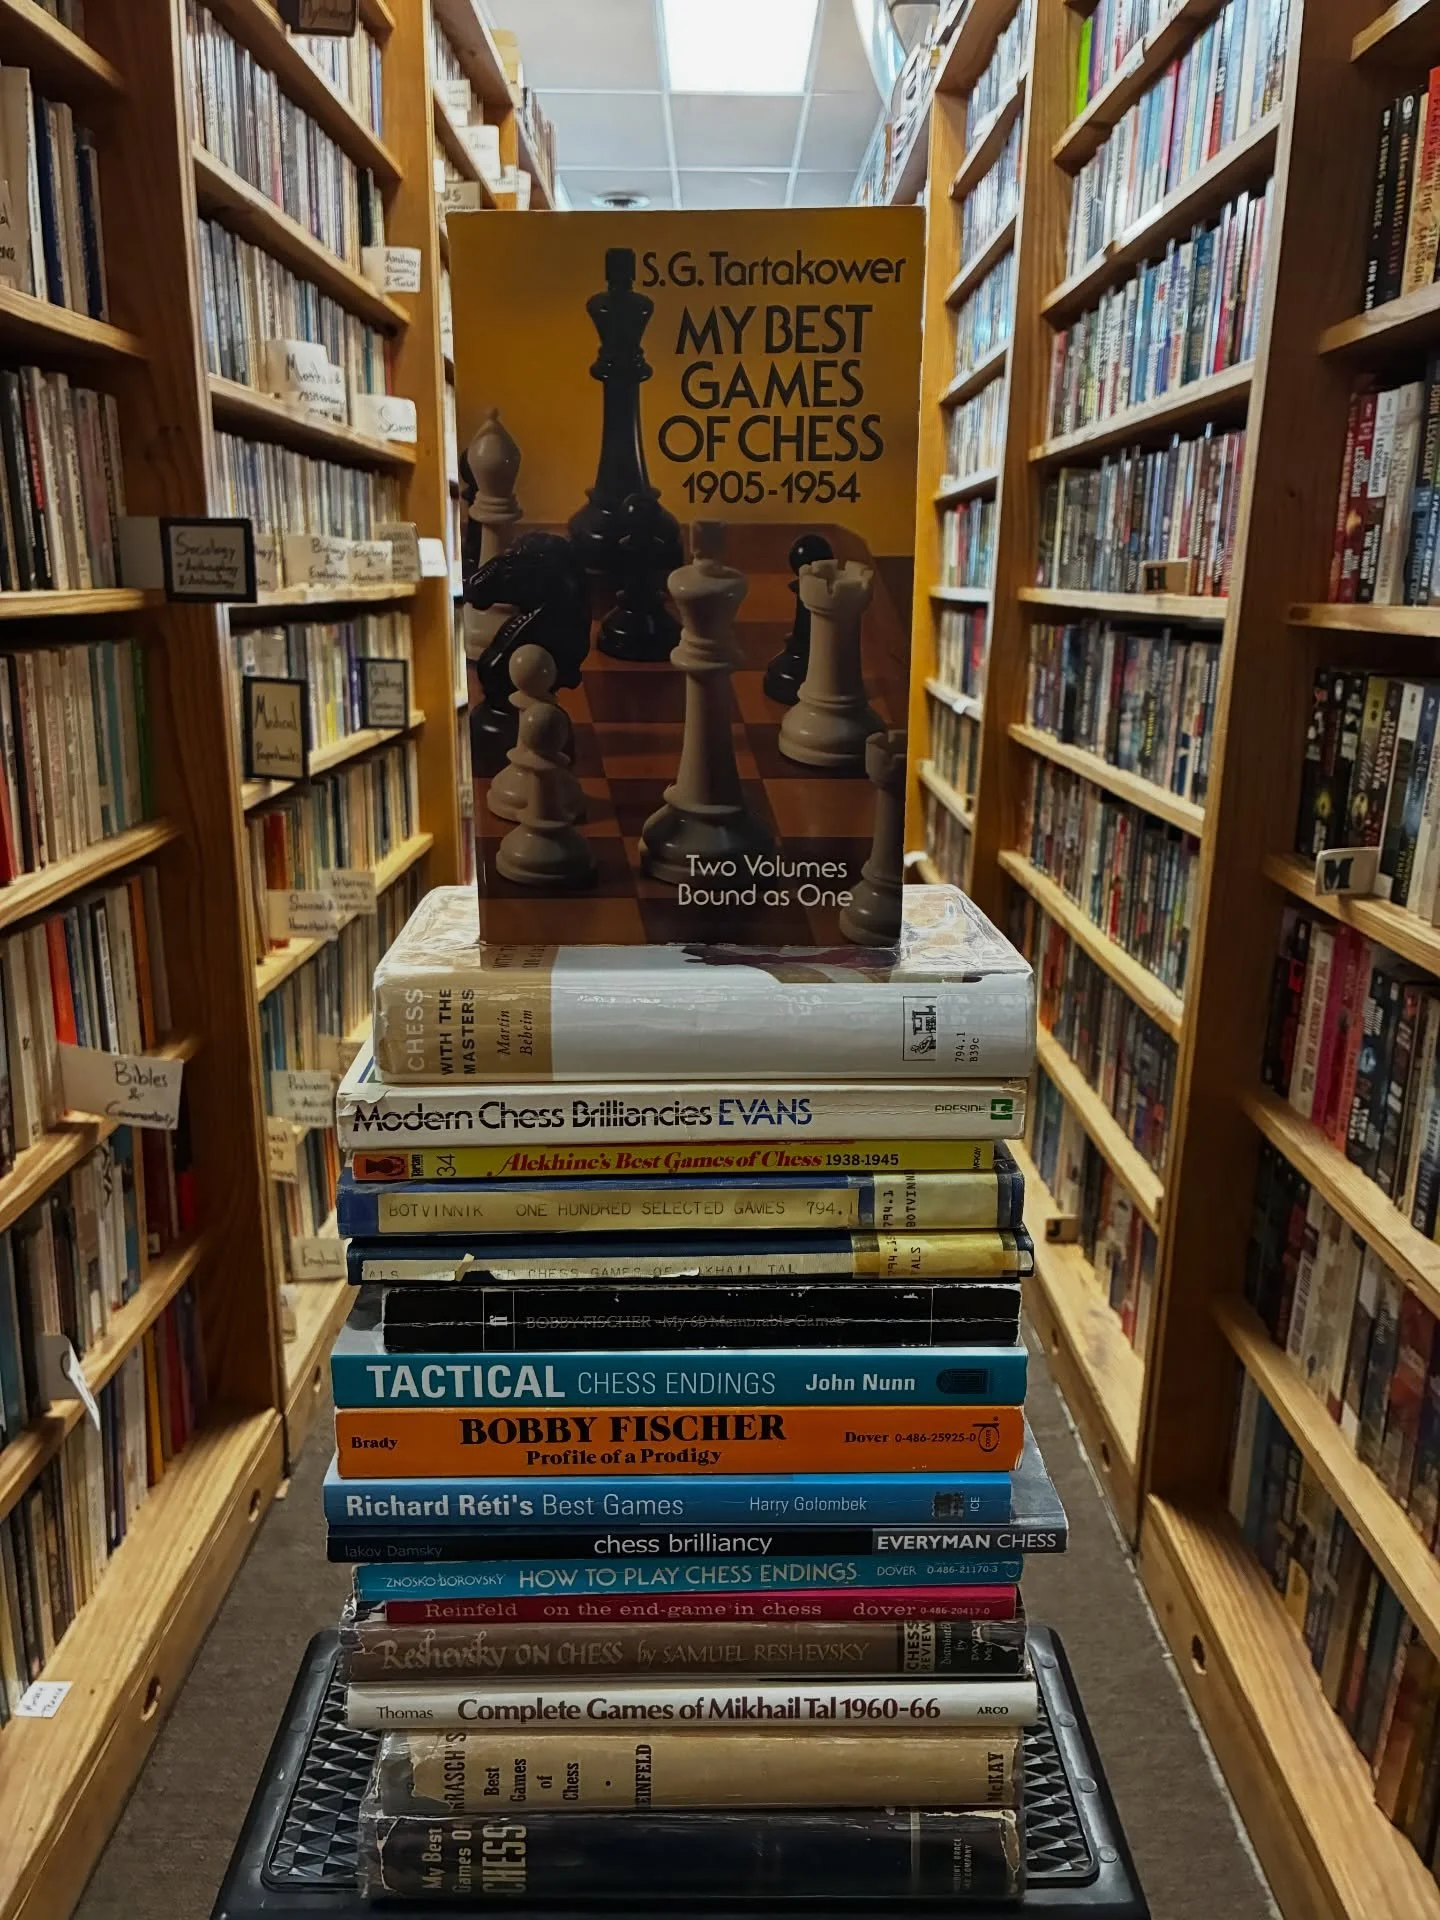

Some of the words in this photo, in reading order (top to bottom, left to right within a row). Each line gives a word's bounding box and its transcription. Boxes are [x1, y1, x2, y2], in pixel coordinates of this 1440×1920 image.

[642, 250, 705, 288] S.G.
[709, 249, 906, 287] Tartakower
[1363, 285, 1375, 309] LAN
[675, 305, 757, 355] MY
[765, 303, 873, 355] BEST
[680, 359, 865, 410] GAMES
[658, 415, 731, 464] OF
[737, 413, 885, 463] CHESS
[682, 471, 862, 505] 1905-1954
[175, 531, 236, 563] Sociology
[685, 854, 737, 877] Two
[743, 854, 848, 878] Volumes
[1322, 857, 1354, 891] M
[677, 883, 757, 907] Bound
[763, 891, 790, 907] as
[797, 883, 854, 907] One
[438, 988, 452, 1026] THE
[405, 987, 425, 1072] CHESS
[461, 988, 476, 1075] MASTERS
[496, 1009, 511, 1056] Martin
[439, 1032, 455, 1076] WITH
[954, 1031, 966, 1062] 794.1
[969, 1037, 980, 1062] B39c
[114, 1060, 169, 1088] Bibles
[353, 1103, 473, 1132] Modern
[479, 1101, 565, 1130] Chess
[572, 1099, 712, 1128] Brilliancies
[718, 1098, 813, 1126] EVANS
[436, 1153, 456, 1177] 34
[489, 1151, 611, 1178] Alekhine's
[615, 1153, 662, 1170] Best
[663, 1151, 734, 1173] Games
[735, 1150, 757, 1168] of
[761, 1150, 822, 1168] Chess
[825, 1152, 899, 1167] 1938-1945
[388, 1203, 484, 1218] BOTVINNIK
[515, 1202, 548, 1218] ONE
[558, 1202, 632, 1217] HUNDRED
[642, 1200, 724, 1216] SELECTED
[733, 1200, 785, 1216] GAMES
[882, 1190, 895, 1228] 794.1
[526, 1314, 579, 1330] BOBBY
[583, 1314, 652, 1330] FISCHER
[662, 1314, 685, 1332] My
[710, 1313, 791, 1328] Memorable
[794, 1313, 846, 1328] Games
[366, 1364, 566, 1398] TACTICAL
[577, 1371, 656, 1394] CHESS
[666, 1371, 776, 1394] ENDINGS
[805, 1373, 855, 1391] John
[862, 1373, 915, 1391] Nunn
[350, 1436, 399, 1451] Brady
[459, 1416, 598, 1445] BOBBY
[609, 1414, 788, 1443] FISCHER
[843, 1431, 889, 1444] Dover
[894, 1431, 977, 1443] 0-486-25925-0
[526, 1449, 598, 1466] Profile
[600, 1448, 624, 1464] of
[625, 1452, 636, 1464] a
[640, 1447, 722, 1467] Prodigy
[346, 1494, 449, 1518] Richard
[459, 1493, 534, 1516] Réti's
[542, 1494, 595, 1516] Best
[603, 1492, 684, 1517] Games
[749, 1496, 789, 1517] Harry
[794, 1495, 868, 1512] Golombek
[386, 1543, 443, 1560] Damsky
[593, 1535, 660, 1555] chess
[669, 1532, 773, 1555] brilliancy
[877, 1533, 991, 1550] EVERYMAN
[996, 1533, 1057, 1549] CHESS
[519, 1568, 579, 1589] HOW
[584, 1567, 617, 1587] TO
[624, 1566, 681, 1586] PLAY
[685, 1565, 752, 1585] CHESS
[760, 1562, 858, 1583] ENDINGS
[876, 1565, 917, 1577] DOVER
[425, 1603, 519, 1618] Reinfeld
[543, 1605, 569, 1617] on
[578, 1603, 612, 1617] the
[618, 1602, 727, 1619] end-game
[735, 1602, 755, 1615] in
[762, 1602, 822, 1616] chess
[853, 1602, 916, 1617] dover
[373, 1631, 513, 1670] Reshevsky
[515, 1645, 550, 1665] ON
[557, 1642, 623, 1666] CHESS
[637, 1640, 657, 1664] by
[664, 1643, 749, 1664] SAMUEL
[753, 1642, 869, 1662] RESHEVSKY
[906, 1621, 920, 1671] CHESS
[376, 1706, 433, 1720] Thomas
[457, 1697, 581, 1724] Complete
[586, 1697, 674, 1721] Games
[678, 1697, 705, 1720] of
[708, 1696, 801, 1720] Mikhail
[804, 1697, 837, 1720] Tal
[839, 1697, 941, 1720] 1960-66
[977, 1706, 1009, 1715] ARCO
[483, 1766, 500, 1797] Best
[510, 1757, 527, 1803] Games
[537, 1774, 553, 1790] of
[562, 1761, 579, 1802] Chess
[423, 1827, 443, 1863] Best
[482, 1822, 527, 1895] CHESS
[421, 1862, 447, 1890] My
[451, 1847, 472, 1894] Games
